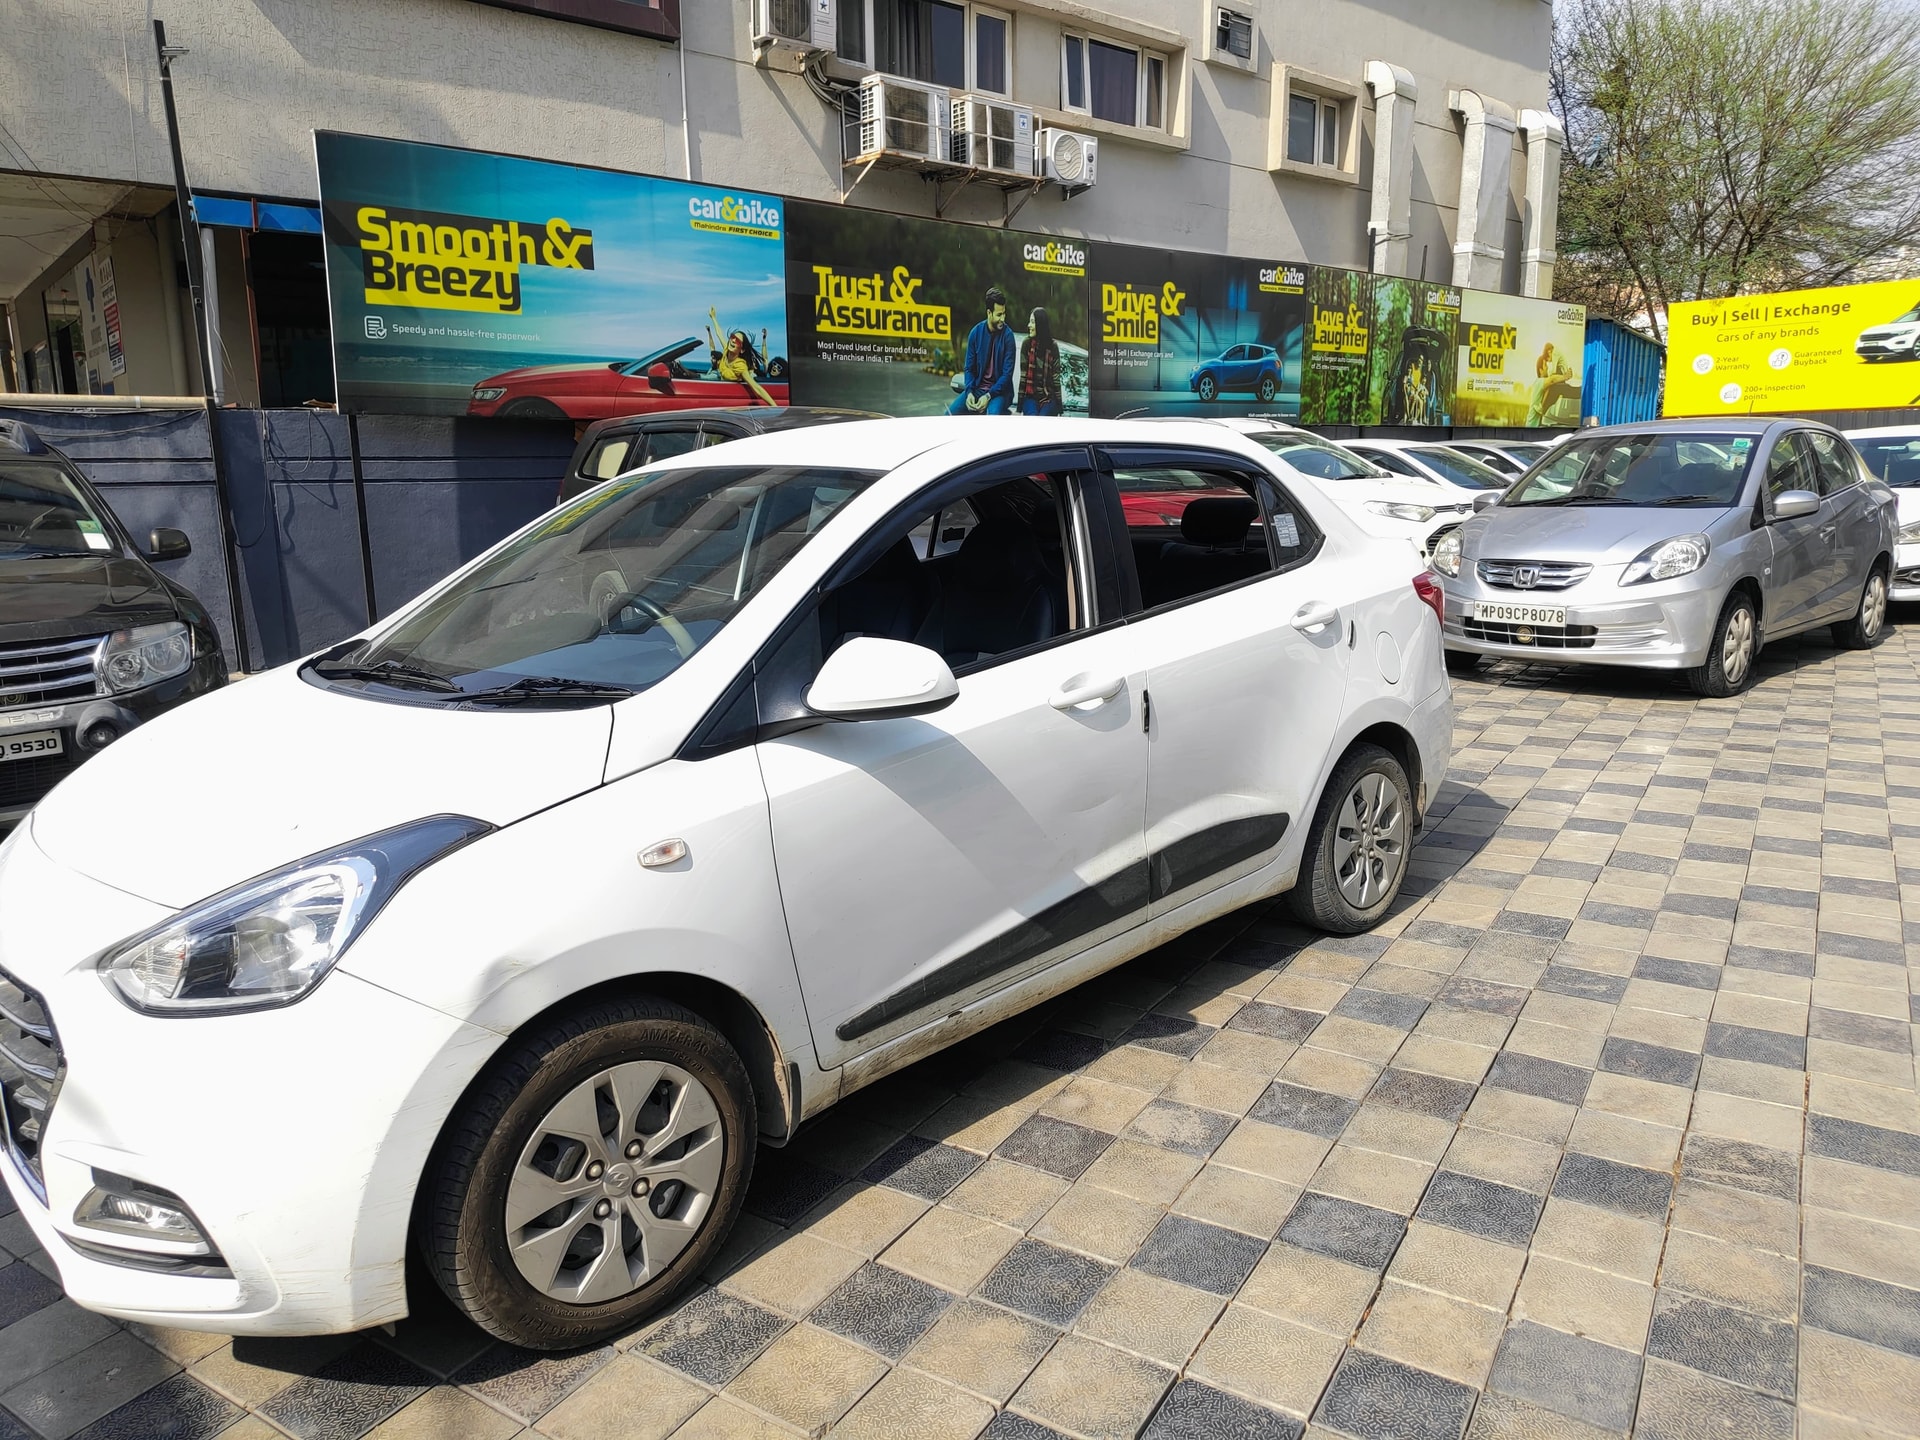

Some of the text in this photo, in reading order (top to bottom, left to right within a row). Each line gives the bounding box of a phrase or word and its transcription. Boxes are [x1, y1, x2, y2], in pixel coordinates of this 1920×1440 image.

[689, 196, 779, 227] car&bike
[357, 207, 592, 269] Smooth &
[728, 226, 748, 234] FIRST
[749, 229, 773, 237] CHOICE
[1023, 242, 1085, 266] car&bike
[362, 250, 521, 311] Breezy
[812, 265, 923, 304] Trust &
[1260, 266, 1304, 285] car&bike
[1102, 281, 1186, 316] Drive &
[1427, 289, 1460, 306] car&bike
[816, 297, 948, 335] Assurance
[1313, 303, 1363, 328] Love &
[1692, 314, 1718, 326] Buy
[1732, 308, 1760, 322] Sell
[1774, 303, 1851, 319] Exchange
[392, 324, 426, 336] Speedy
[429, 326, 445, 335] and
[447, 327, 495, 339] hassle-free
[1103, 311, 1157, 339] Smile
[1717, 326, 1820, 342] Cars of any brands
[1313, 325, 1367, 350] Laughter
[1469, 322, 1517, 349] Care &
[817, 341, 834, 349] Most
[836, 342, 853, 350] loved
[855, 343, 872, 352] Used
[884, 345, 903, 354] brand
[904, 346, 911, 354] of
[912, 347, 927, 355] India
[1103, 348, 1114, 357] Buy
[1130, 350, 1153, 359] Exchange
[1795, 349, 1842, 358] Guaranteed
[822, 352, 832, 361] By
[833, 353, 865, 361] Franchise
[865, 355, 884, 364] India,
[1469, 347, 1503, 370] Cover
[1716, 363, 1750, 371] Warranty
[1794, 358, 1828, 366] Buyback
[1744, 393, 1768, 401] points
[1765, 384, 1805, 392] inspection
[1482, 605, 1563, 622] MP09CP8078
